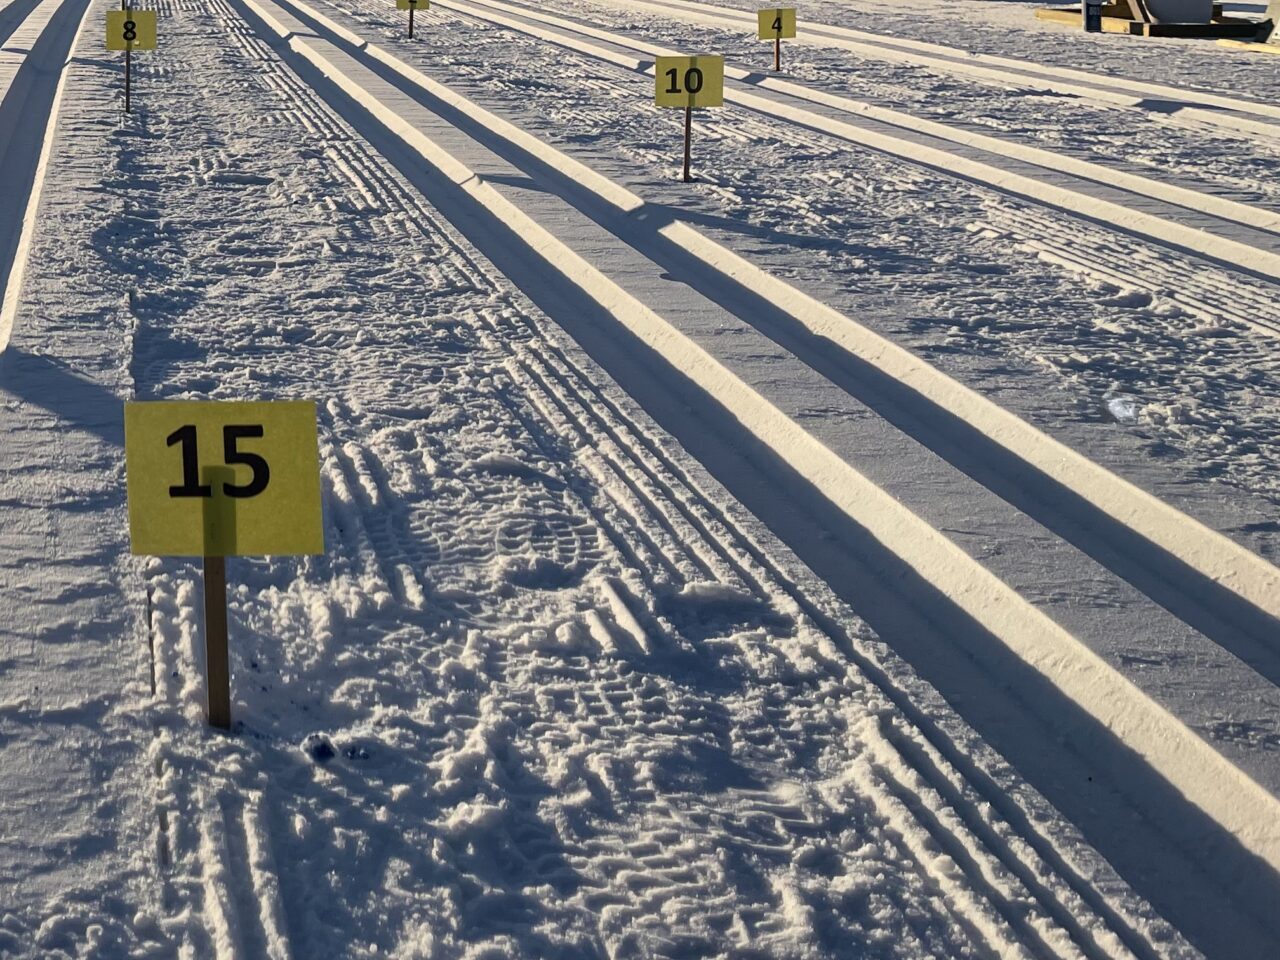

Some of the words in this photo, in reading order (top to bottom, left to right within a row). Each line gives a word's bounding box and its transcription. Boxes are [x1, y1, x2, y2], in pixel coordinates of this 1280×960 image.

[122, 20, 137, 41] 8
[771, 16, 783, 33] 4
[665, 67, 704, 94] 10
[166, 424, 270, 499] 15
